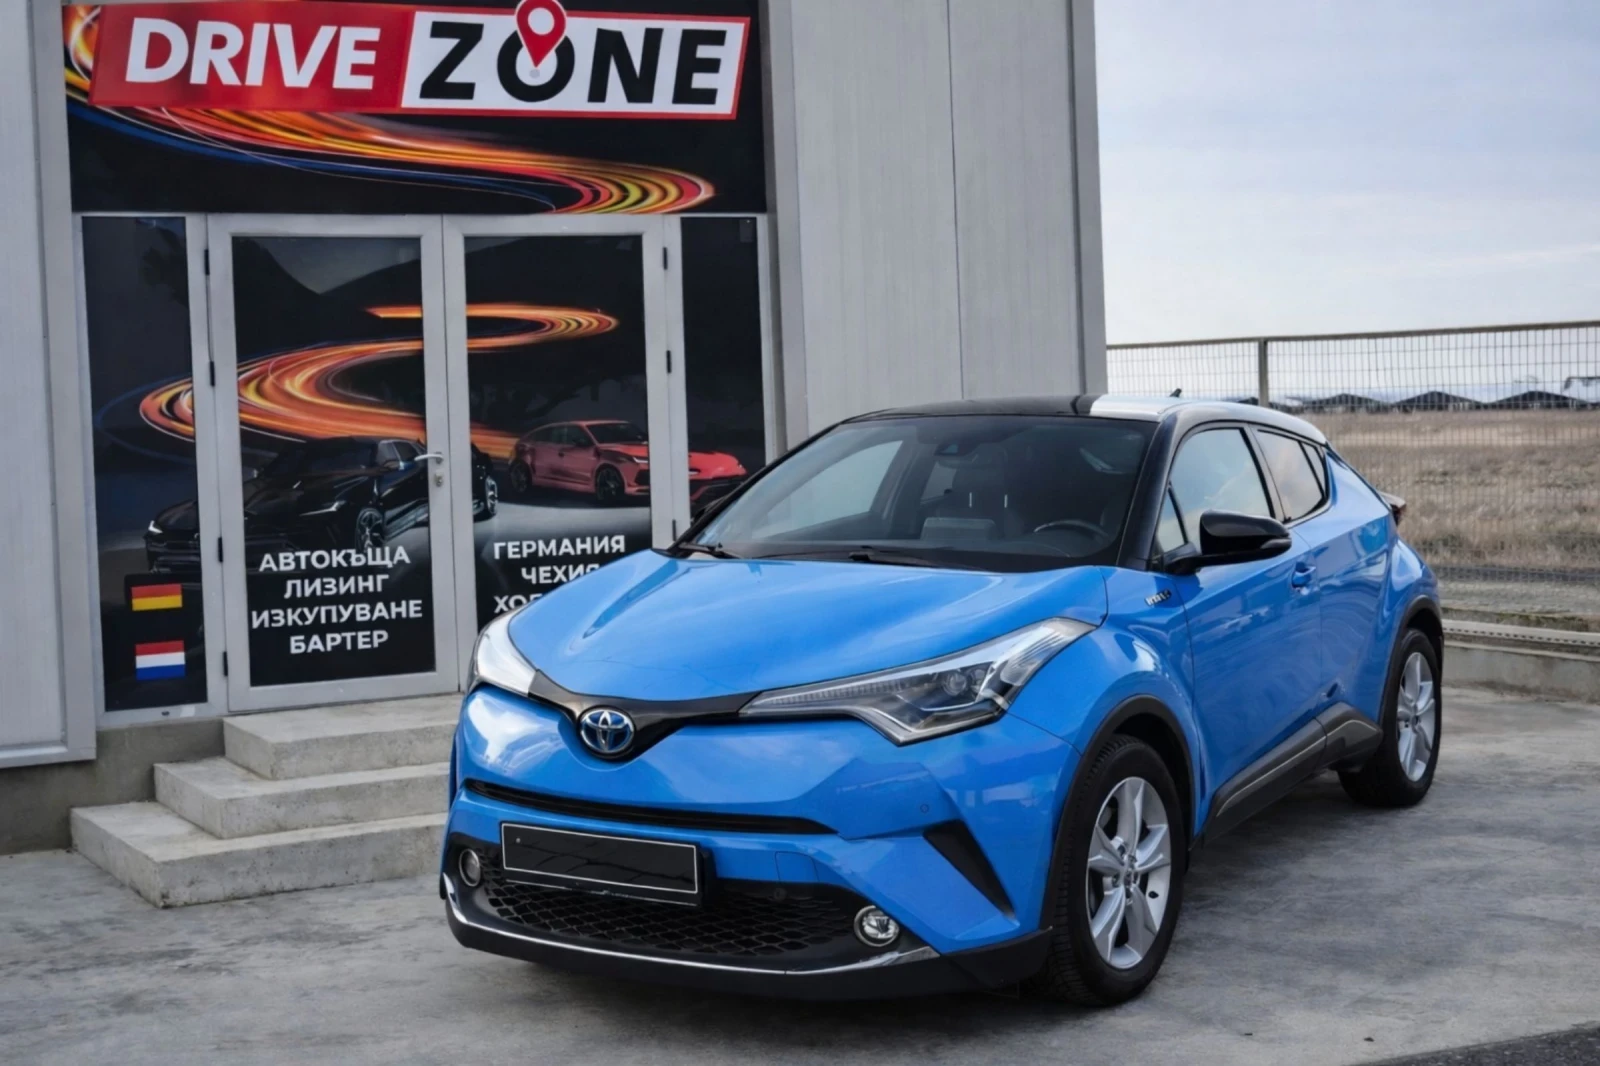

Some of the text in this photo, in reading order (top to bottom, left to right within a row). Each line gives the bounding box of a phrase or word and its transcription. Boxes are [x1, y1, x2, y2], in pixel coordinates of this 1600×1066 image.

[125, 17, 728, 106] DRIVE ZONE
[258, 545, 411, 572] АВТОКЪЩА
[493, 534, 626, 560] ГЕРМАНИЯ
[283, 574, 390, 599] ЛИЗИНГ
[251, 599, 423, 629] ИЗКУПУВАНЕ
[289, 629, 389, 655] БАРТЕР
